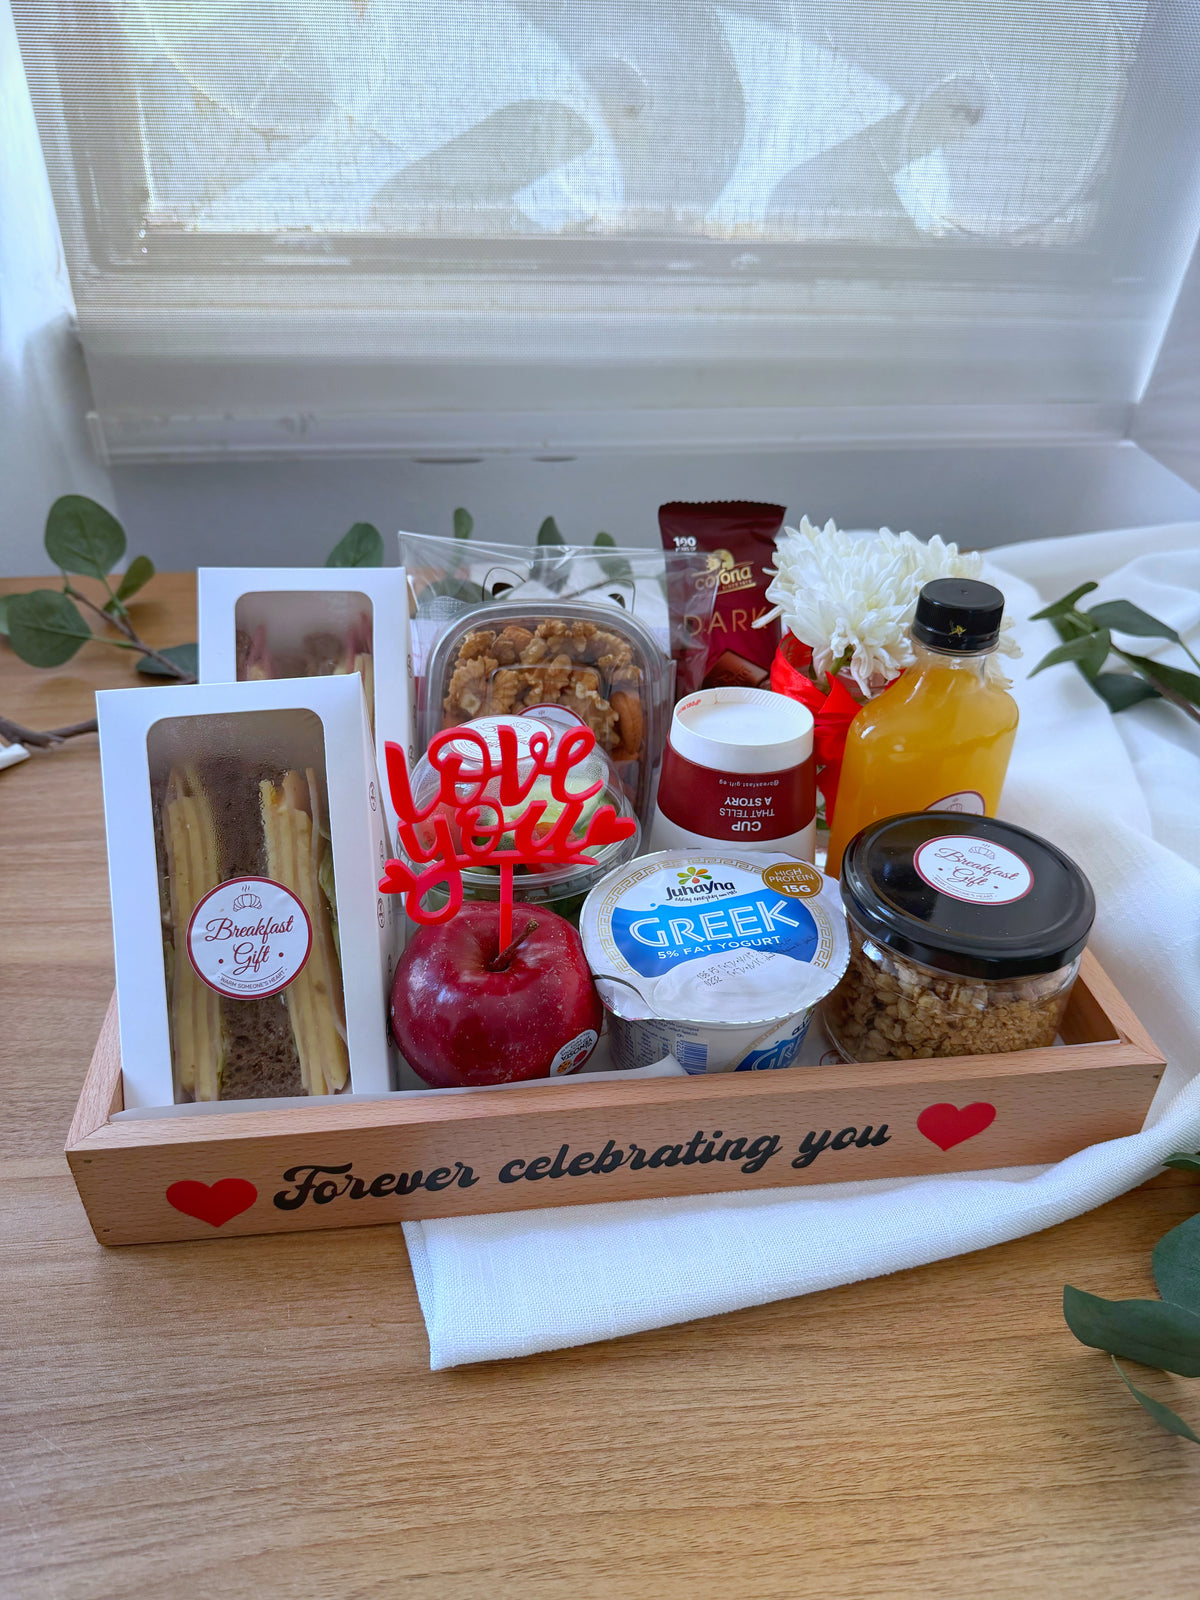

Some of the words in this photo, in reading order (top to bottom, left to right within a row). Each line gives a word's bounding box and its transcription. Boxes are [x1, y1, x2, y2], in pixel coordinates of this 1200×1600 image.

[694, 566, 752, 591] corona
[724, 796, 762, 807] STORY
[764, 796, 773, 806] A
[719, 807, 749, 818] TELLS
[750, 808, 775, 818] THAT
[731, 820, 762, 832] CUP
[396, 796, 602, 926] you
[934, 847, 1020, 881] Breakfast
[768, 874, 814, 883] PROTEIN
[774, 868, 802, 877] HIGH
[946, 866, 989, 888] Gift
[665, 880, 736, 901] Juhayna
[782, 884, 811, 893] 15G
[204, 915, 294, 945] Breakfast
[629, 900, 800, 948] GREEK
[657, 949, 680, 960] 5%
[683, 944, 713, 956] FAT
[717, 935, 780, 950] YOGURT
[232, 941, 270, 976] Gift
[220, 976, 237, 987] WARM
[268, 970, 285, 983] HEART
[273, 1160, 480, 1211] Forever
[498, 1128, 783, 1184] celebrating
[790, 1122, 893, 1170] you
